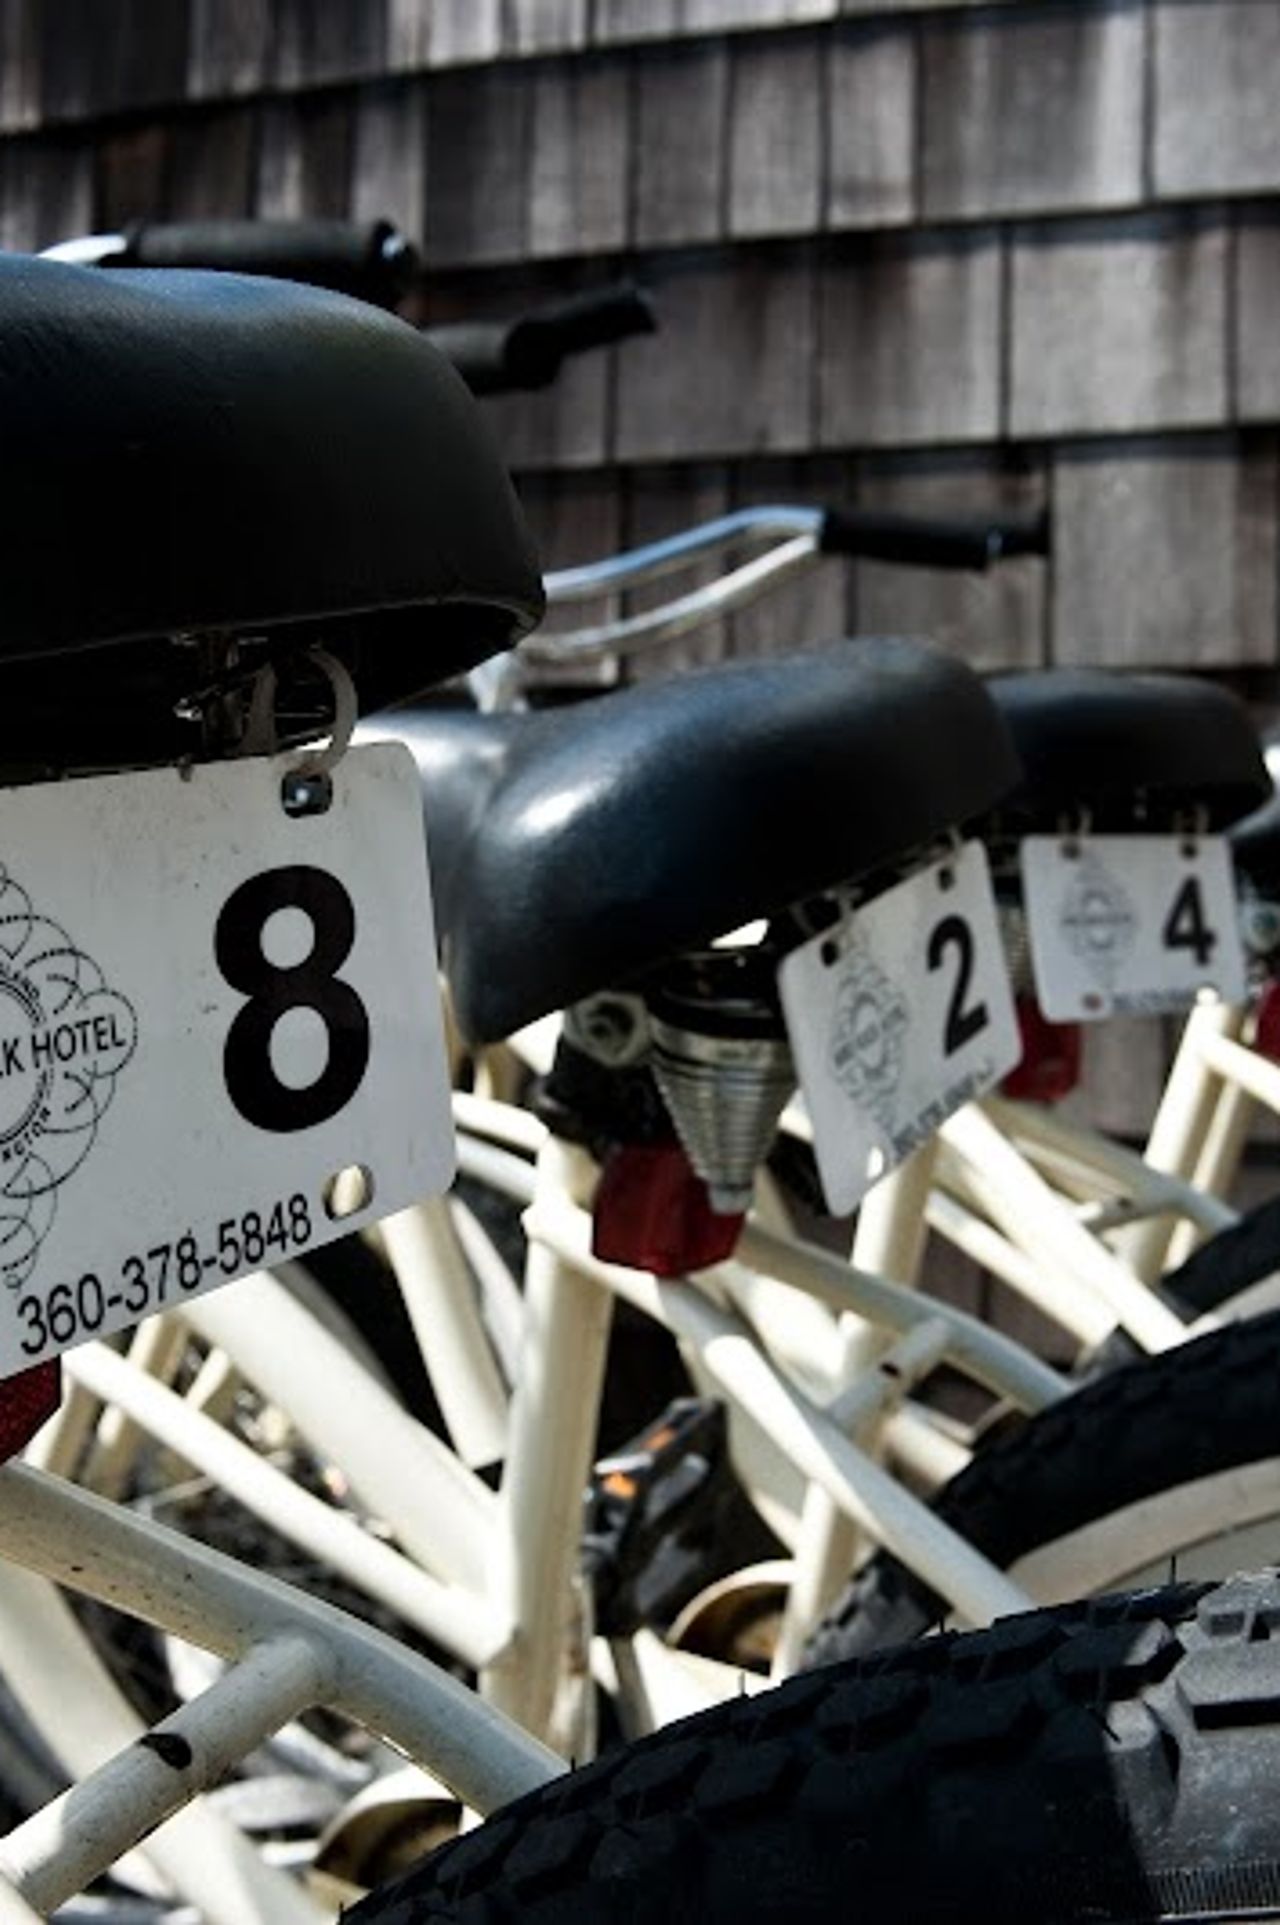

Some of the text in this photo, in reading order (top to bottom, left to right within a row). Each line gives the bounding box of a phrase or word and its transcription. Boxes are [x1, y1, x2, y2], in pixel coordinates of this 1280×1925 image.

[927, 915, 990, 1056] 2
[1163, 877, 1216, 965] 4
[0, 1014, 126, 1076] K HOTEL
[214, 864, 370, 1134] 8
[17, 1194, 312, 1355] 360-378-5848
